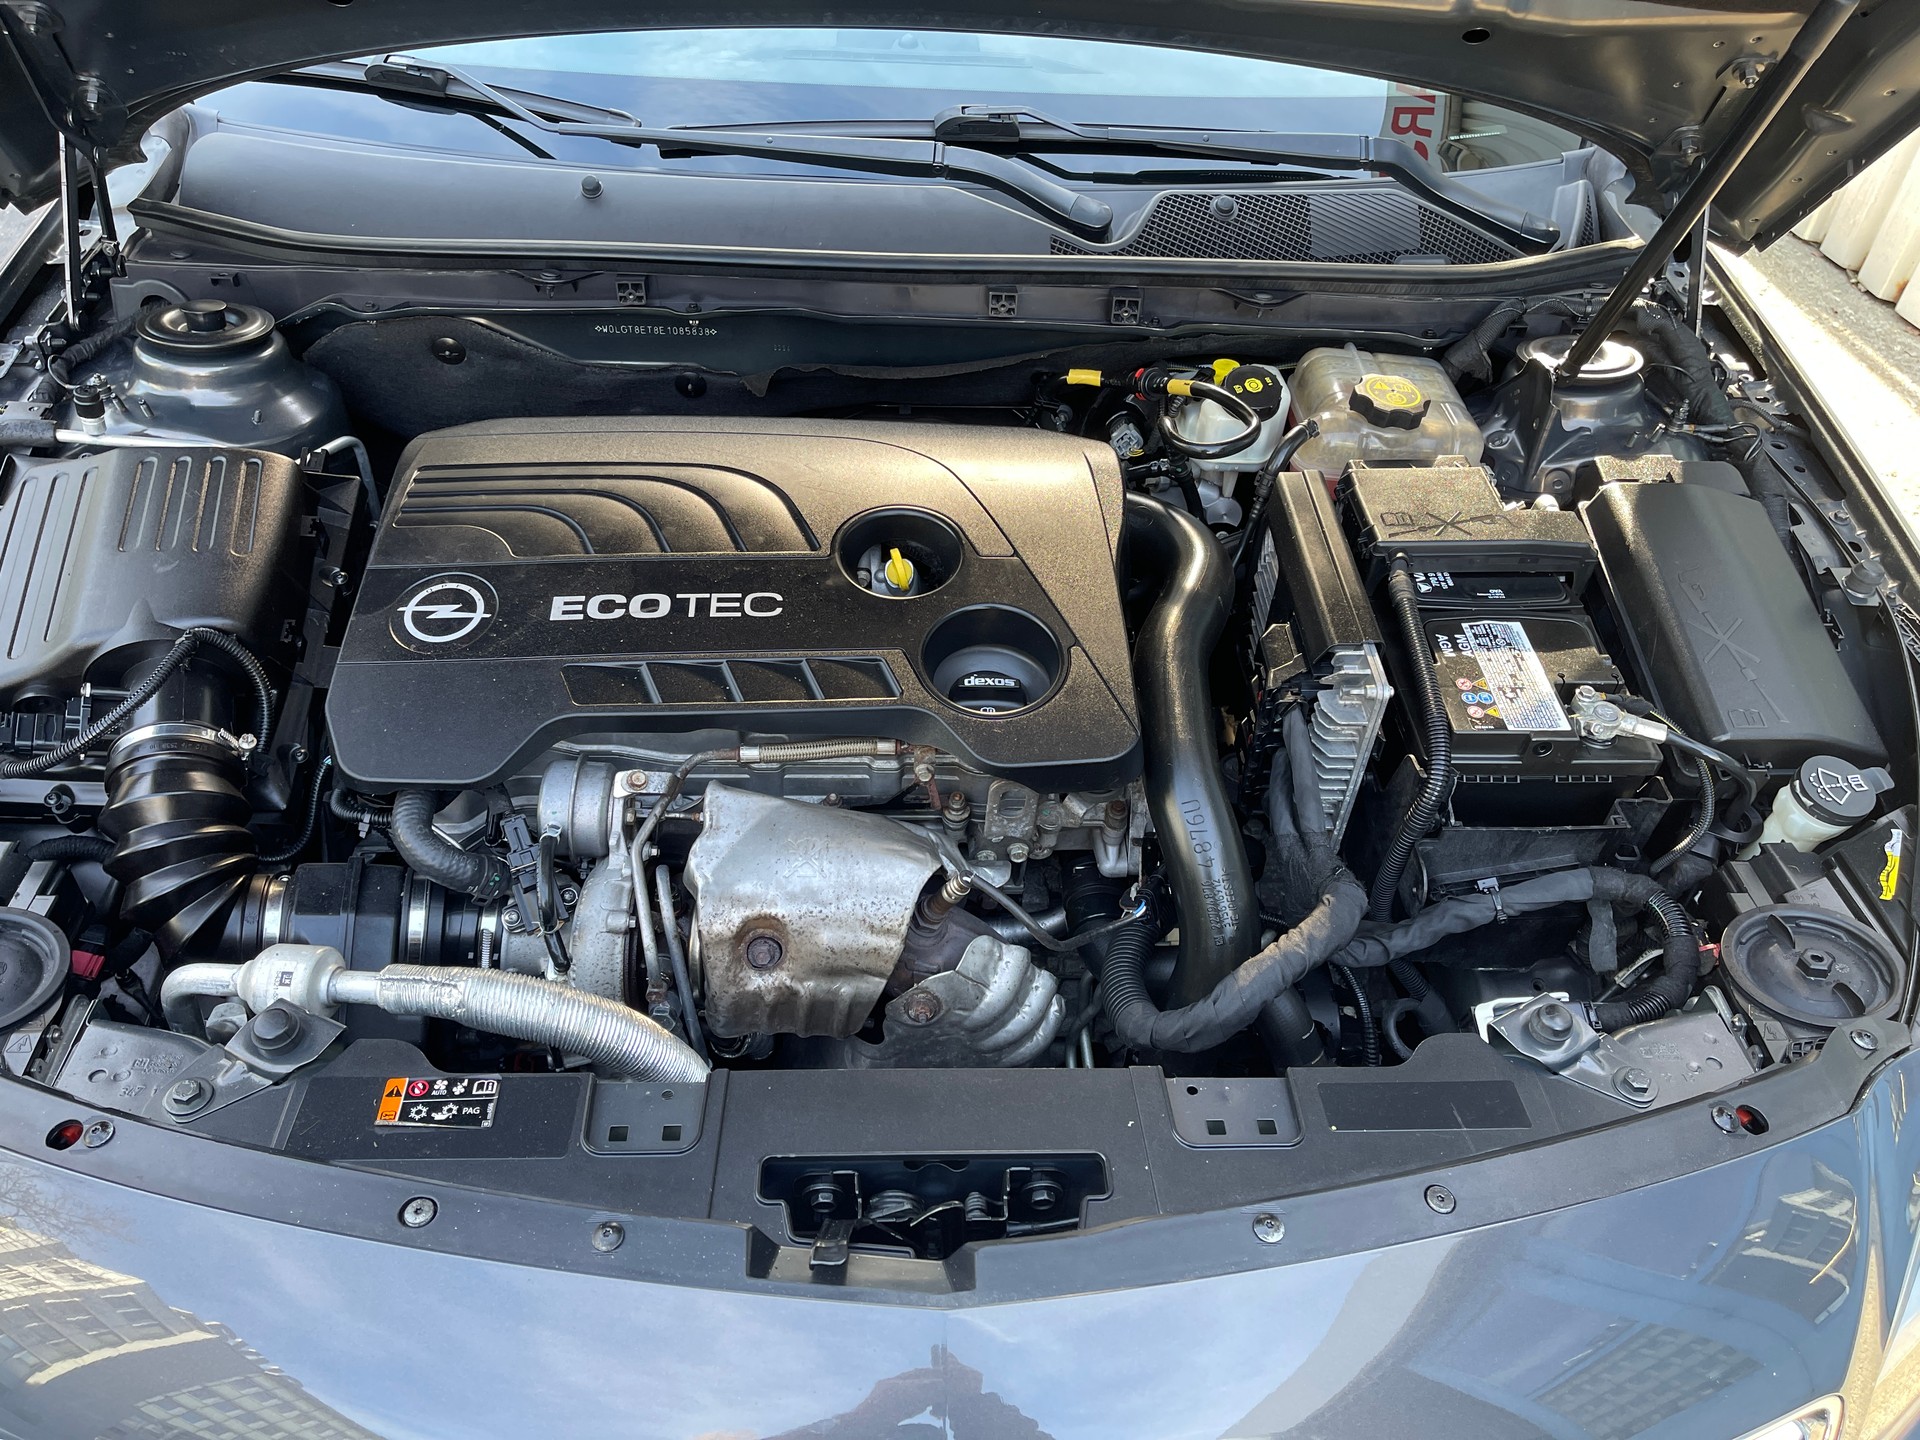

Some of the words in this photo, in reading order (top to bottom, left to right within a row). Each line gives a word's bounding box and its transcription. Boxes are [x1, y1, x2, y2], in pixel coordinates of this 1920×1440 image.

[550, 592, 783, 621] ECOTEC
[1436, 634, 1456, 657] AGM
[1454, 634, 1475, 657] AGM
[964, 676, 1016, 687] dexos
[462, 1106, 480, 1115] PAG
